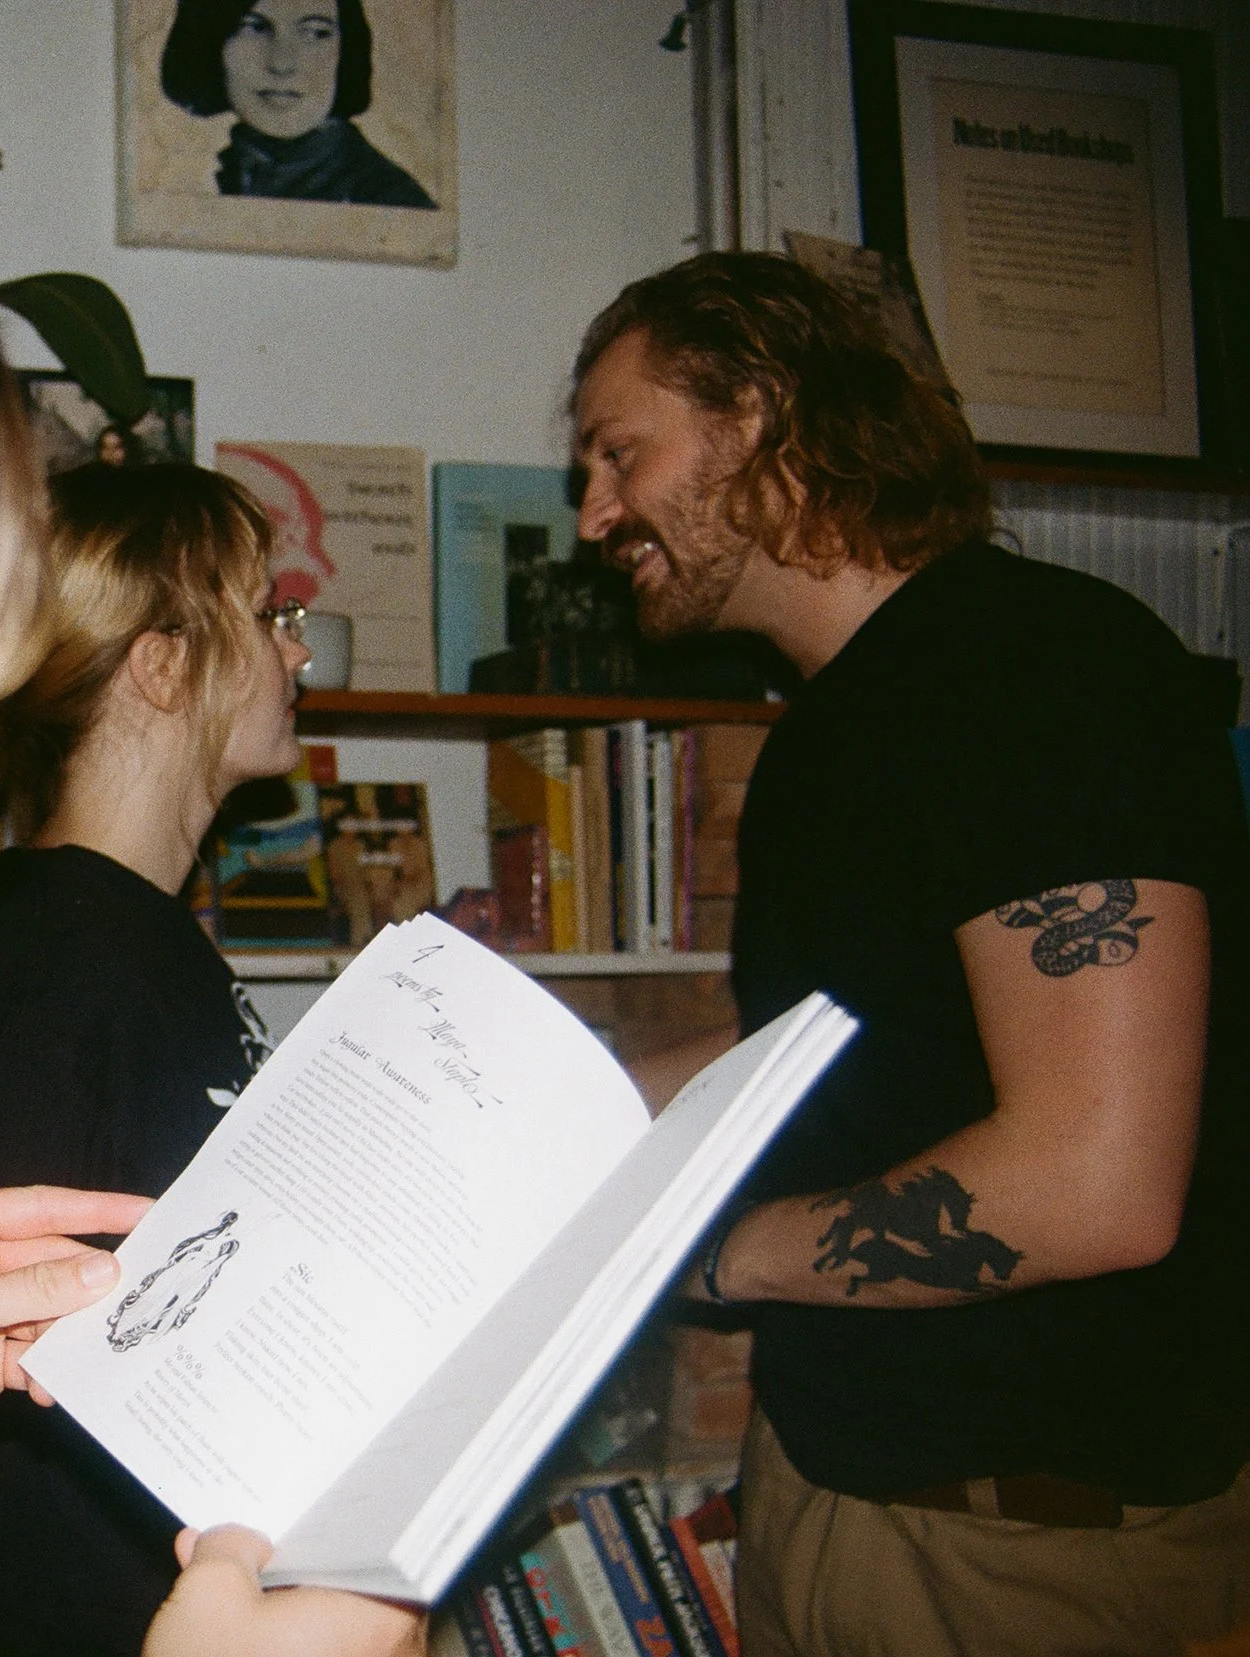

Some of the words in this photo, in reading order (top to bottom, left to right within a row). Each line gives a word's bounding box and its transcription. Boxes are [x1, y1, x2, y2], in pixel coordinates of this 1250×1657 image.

[412, 944, 444, 963] 4
[380, 971, 422, 992] poems
[417, 1019, 467, 1059] Maya
[329, 1032, 371, 1060] Jugular
[375, 1057, 432, 1104] Awareness
[290, 1263, 314, 1284] Sic
